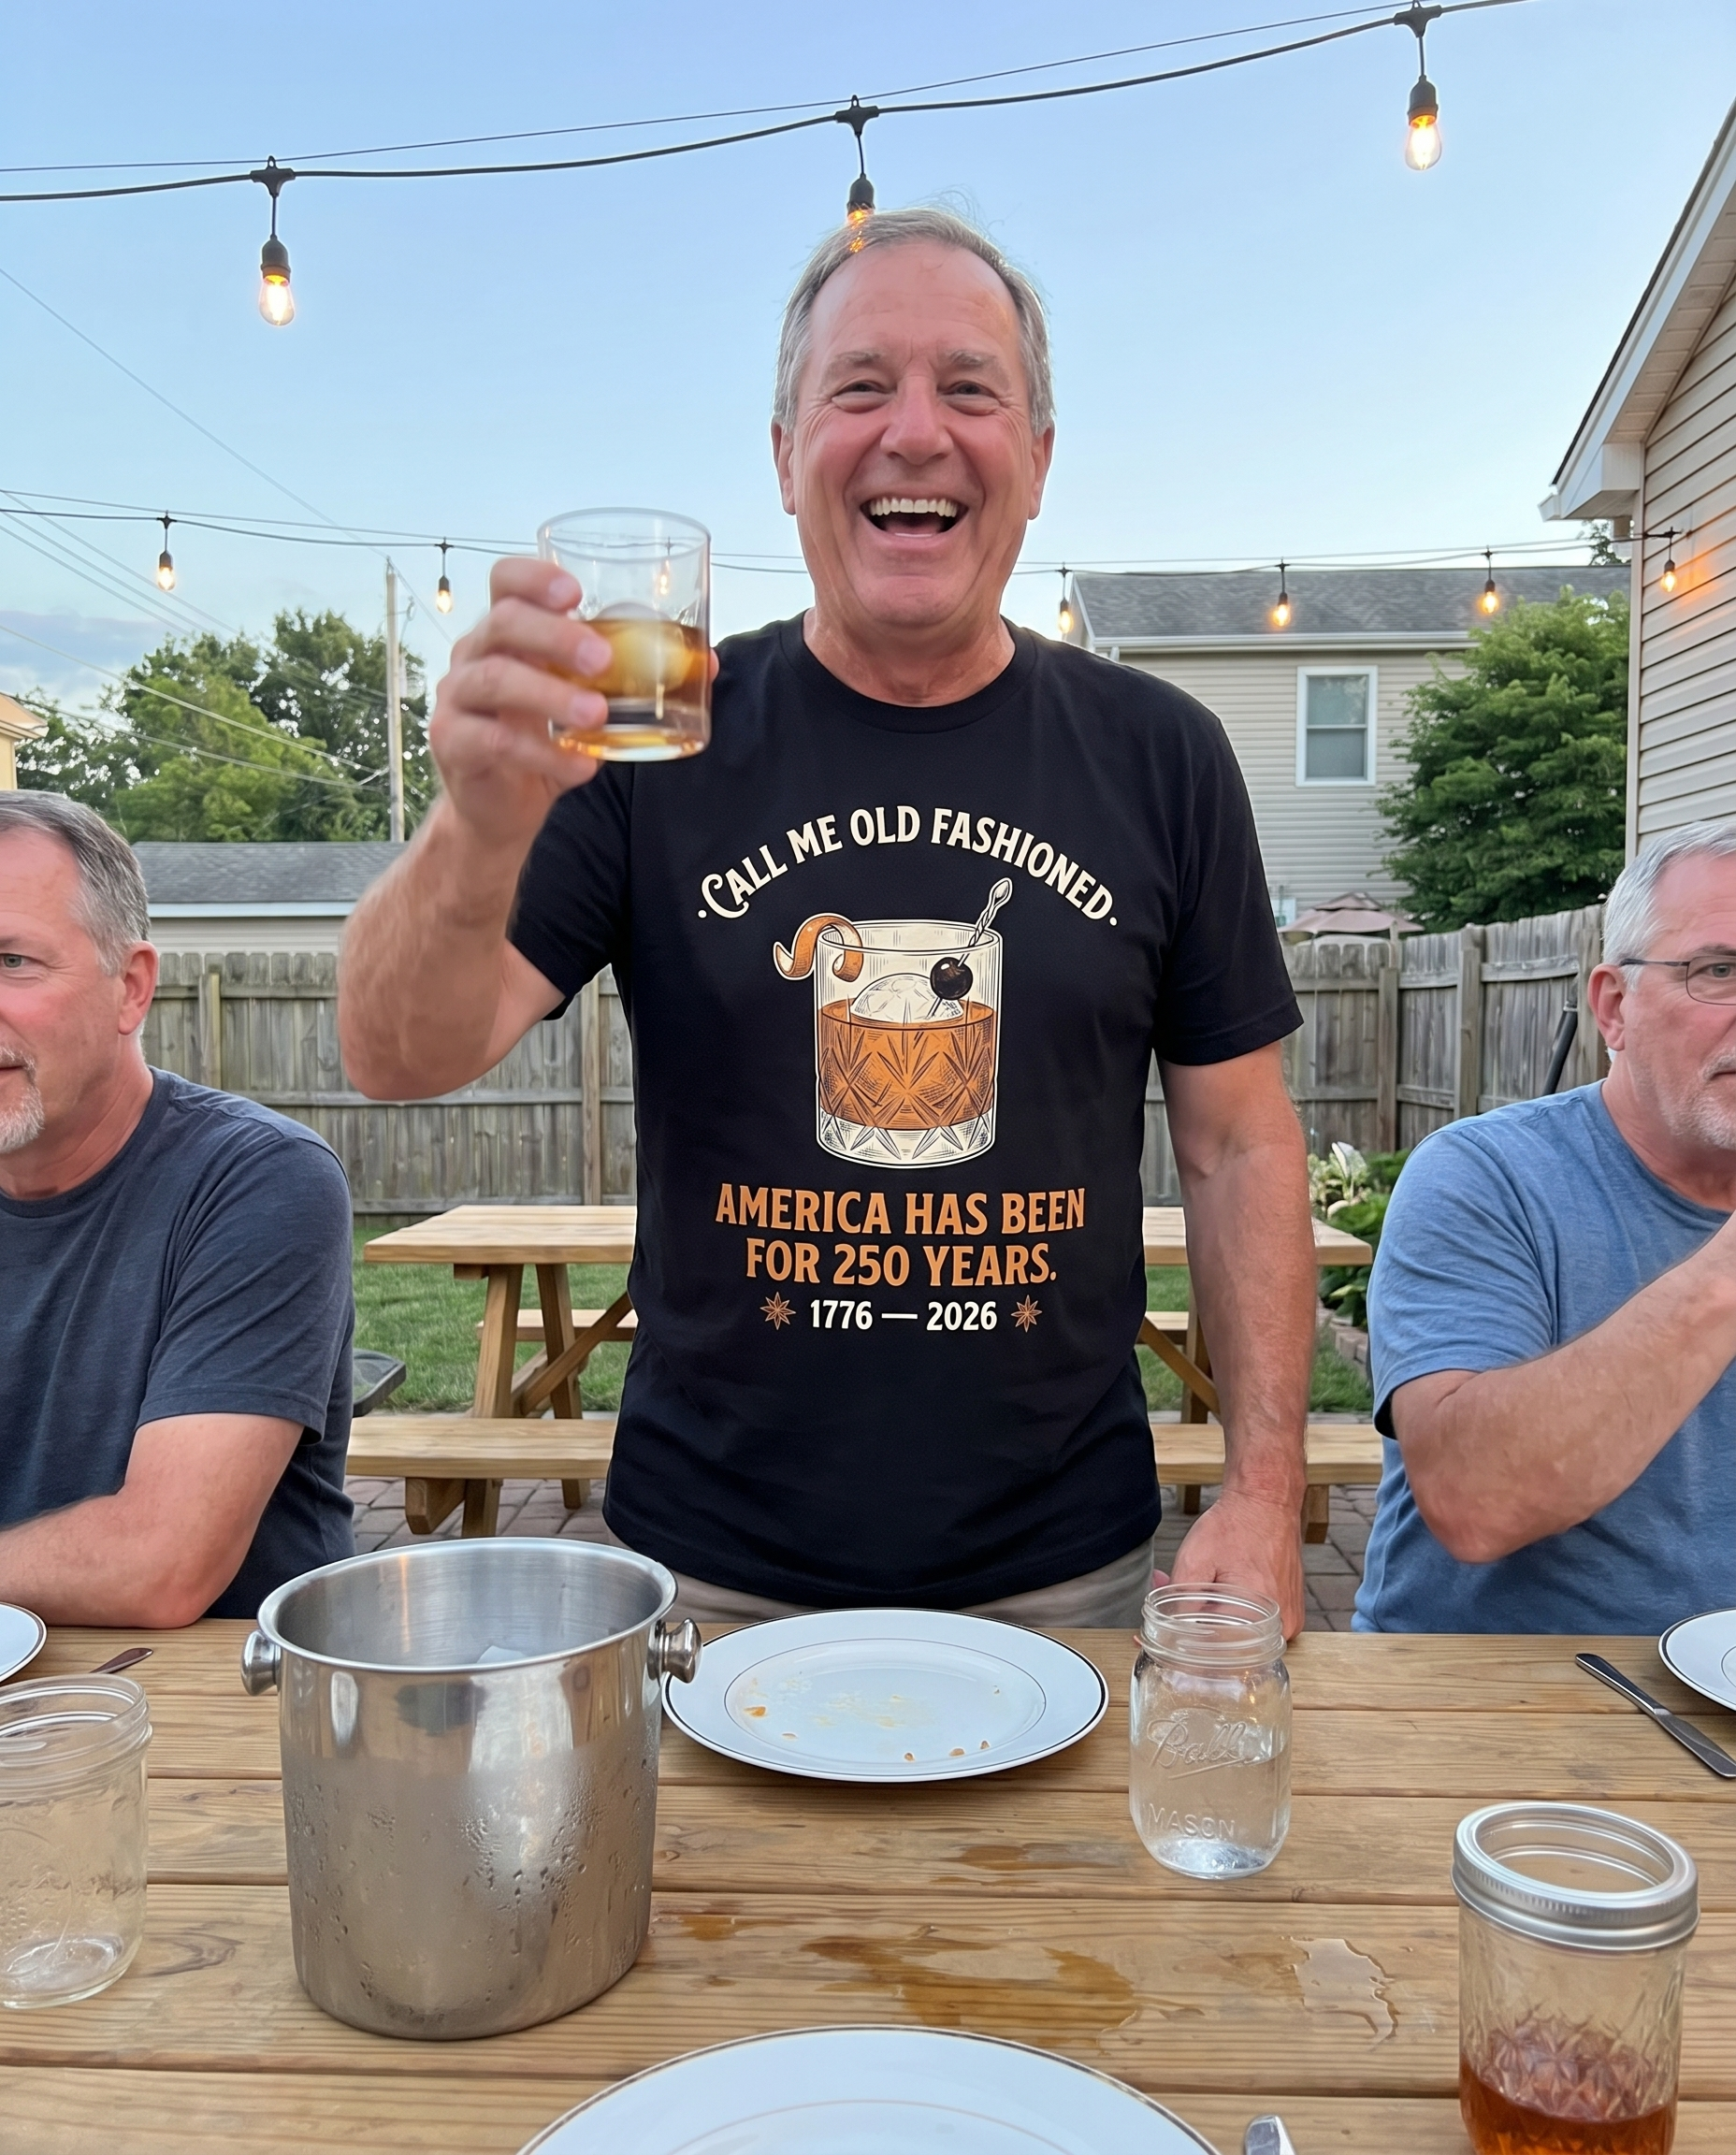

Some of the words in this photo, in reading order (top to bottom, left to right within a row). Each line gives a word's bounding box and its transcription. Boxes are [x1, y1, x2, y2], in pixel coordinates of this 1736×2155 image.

[786, 814, 844, 864] ME
[849, 805, 920, 846] OLD
[716, 1182, 892, 1235] AMERICA
[904, 1193, 988, 1236] HAS
[1001, 1187, 1085, 1235] BEEN
[746, 1237, 820, 1284] FOR
[832, 1243, 910, 1287] 250
[922, 1242, 1057, 1287] YEARS.
[810, 1299, 874, 1330] 1776
[926, 1300, 998, 1331] 2026
[1147, 1717, 1246, 1771] Ball
[1147, 1802, 1236, 1840] MASON
